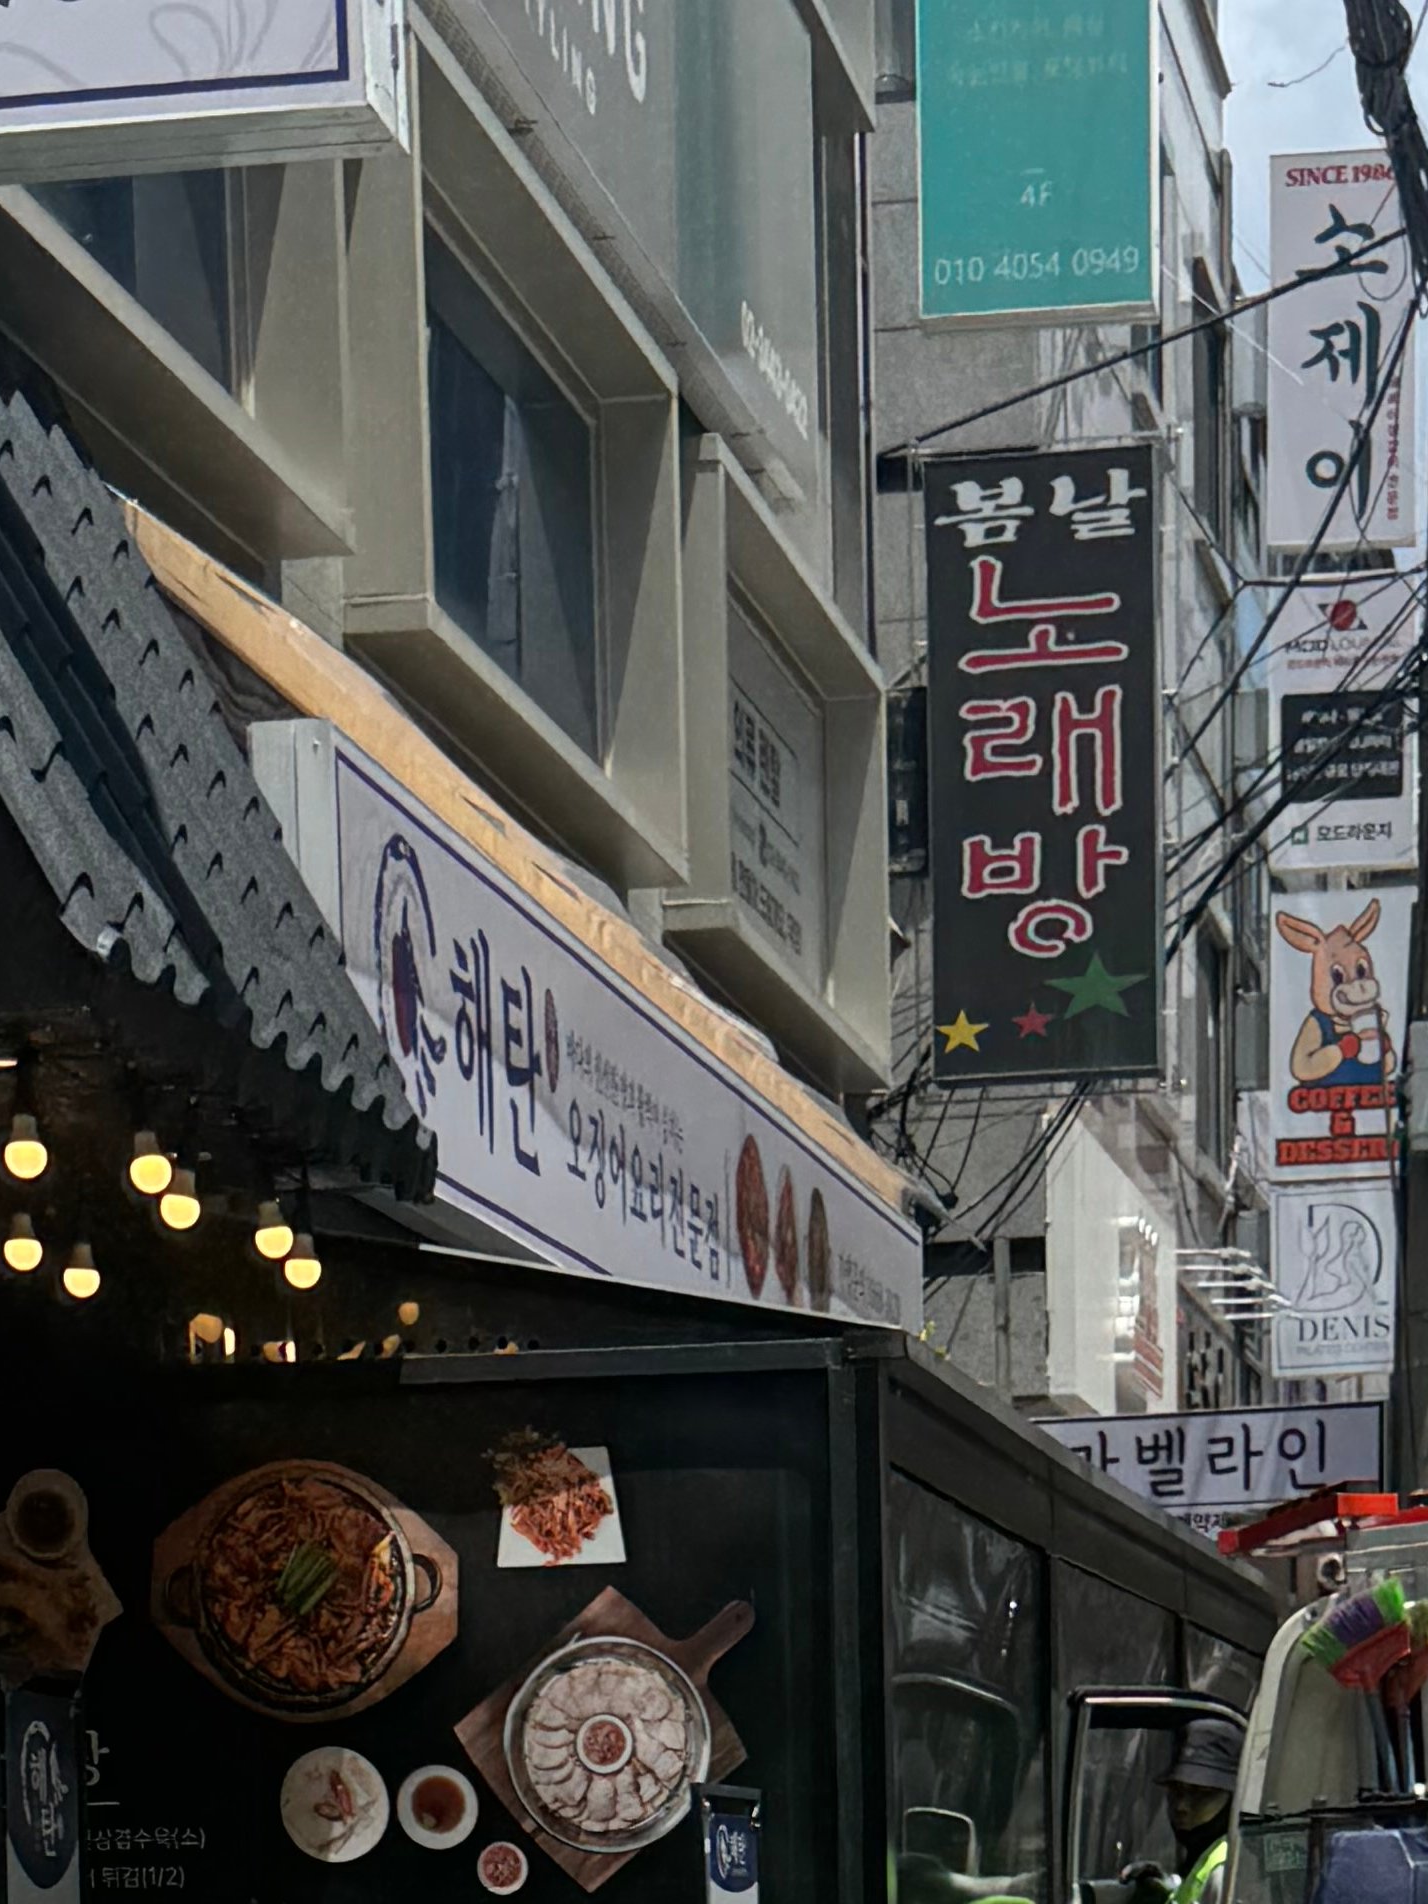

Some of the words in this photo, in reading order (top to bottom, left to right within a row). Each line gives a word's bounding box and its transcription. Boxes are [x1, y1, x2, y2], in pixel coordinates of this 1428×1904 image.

[1285, 167, 1348, 188] SINCE
[934, 257, 984, 285] 010
[993, 251, 1060, 281] 4054
[1072, 245, 1139, 276] 0949
[934, 468, 1148, 548] 봄날
[958, 555, 1130, 958] 노래방
[1316, 822, 1392, 842] 모드라운지
[449, 927, 543, 1177] 해탄
[566, 1098, 720, 1281] 오징어요리전문점
[1298, 1314, 1390, 1342] DENIS
